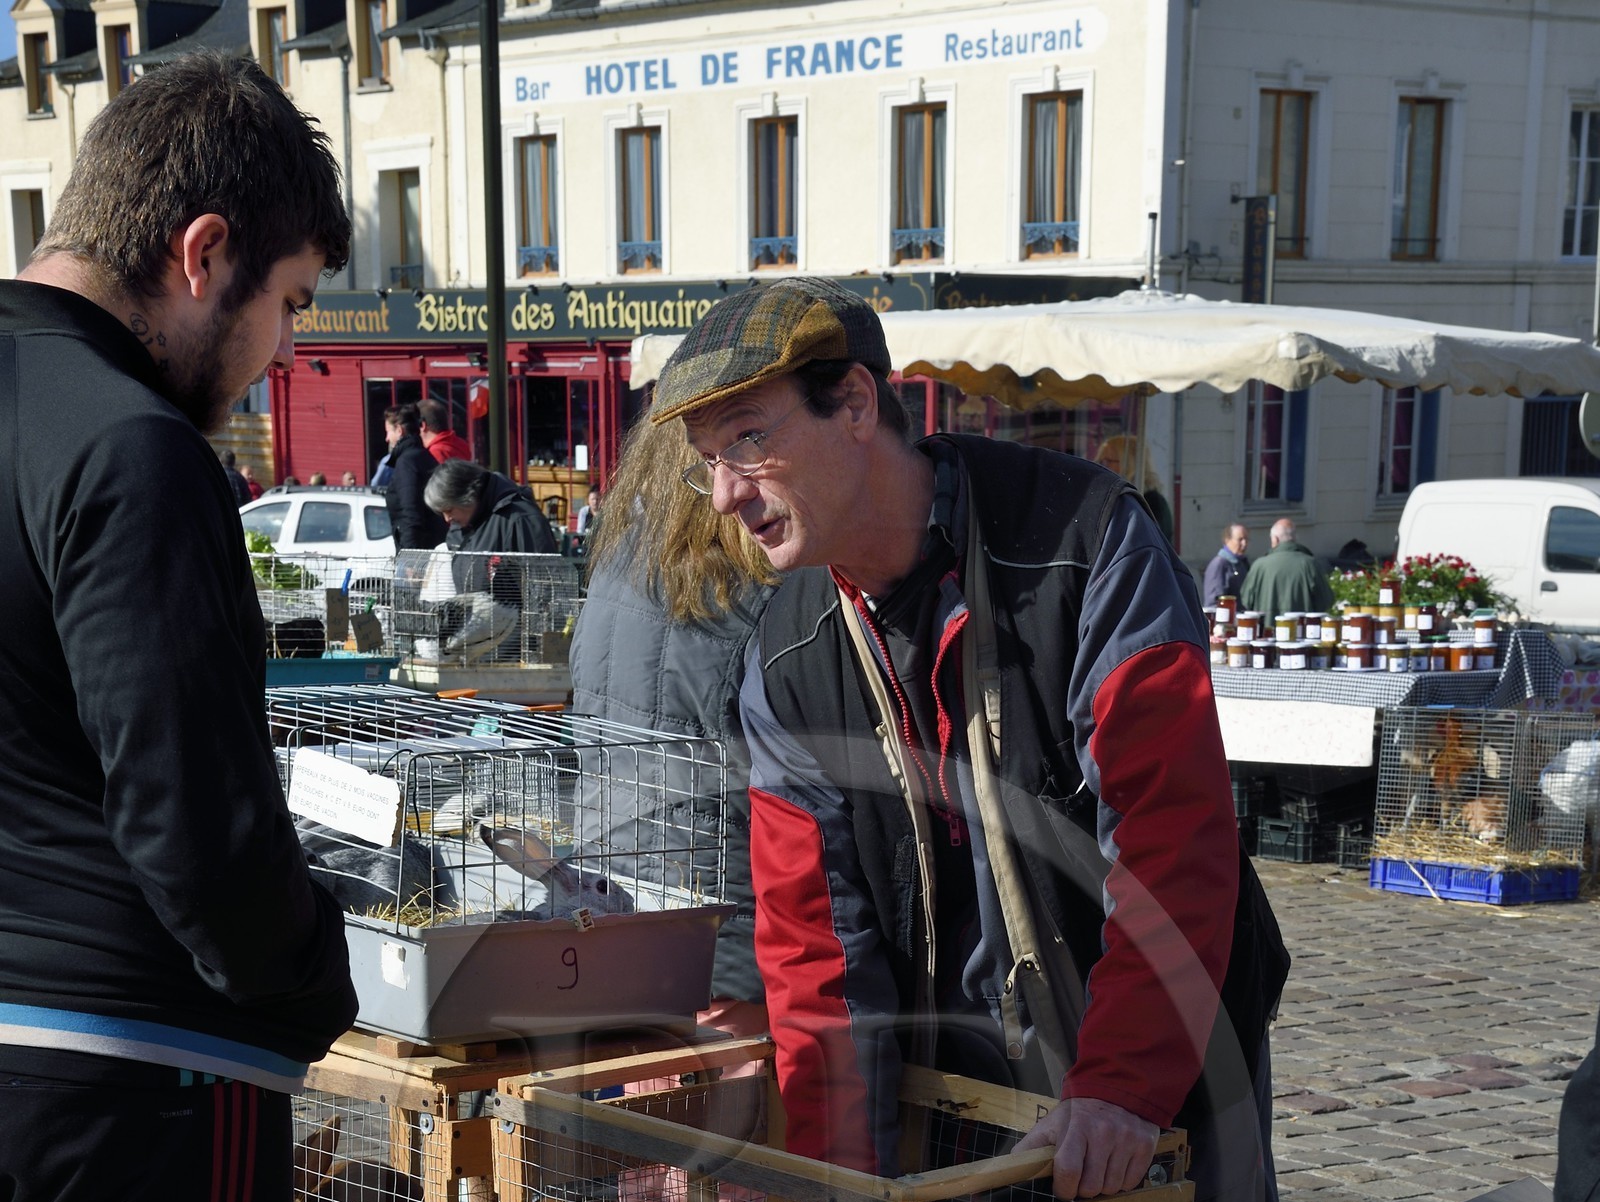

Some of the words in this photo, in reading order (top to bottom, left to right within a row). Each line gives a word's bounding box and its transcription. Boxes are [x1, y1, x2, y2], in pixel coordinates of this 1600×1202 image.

[516, 77, 550, 101] Bar
[586, 58, 676, 96] HOTEL
[701, 52, 738, 86] DE
[766, 34, 903, 79] FRANCE
[945, 19, 1083, 62] Restaurant
[293, 301, 390, 333] estaurant
[511, 291, 555, 331] des
[567, 288, 721, 335] Antiquaire
[557, 947, 579, 990] 9
